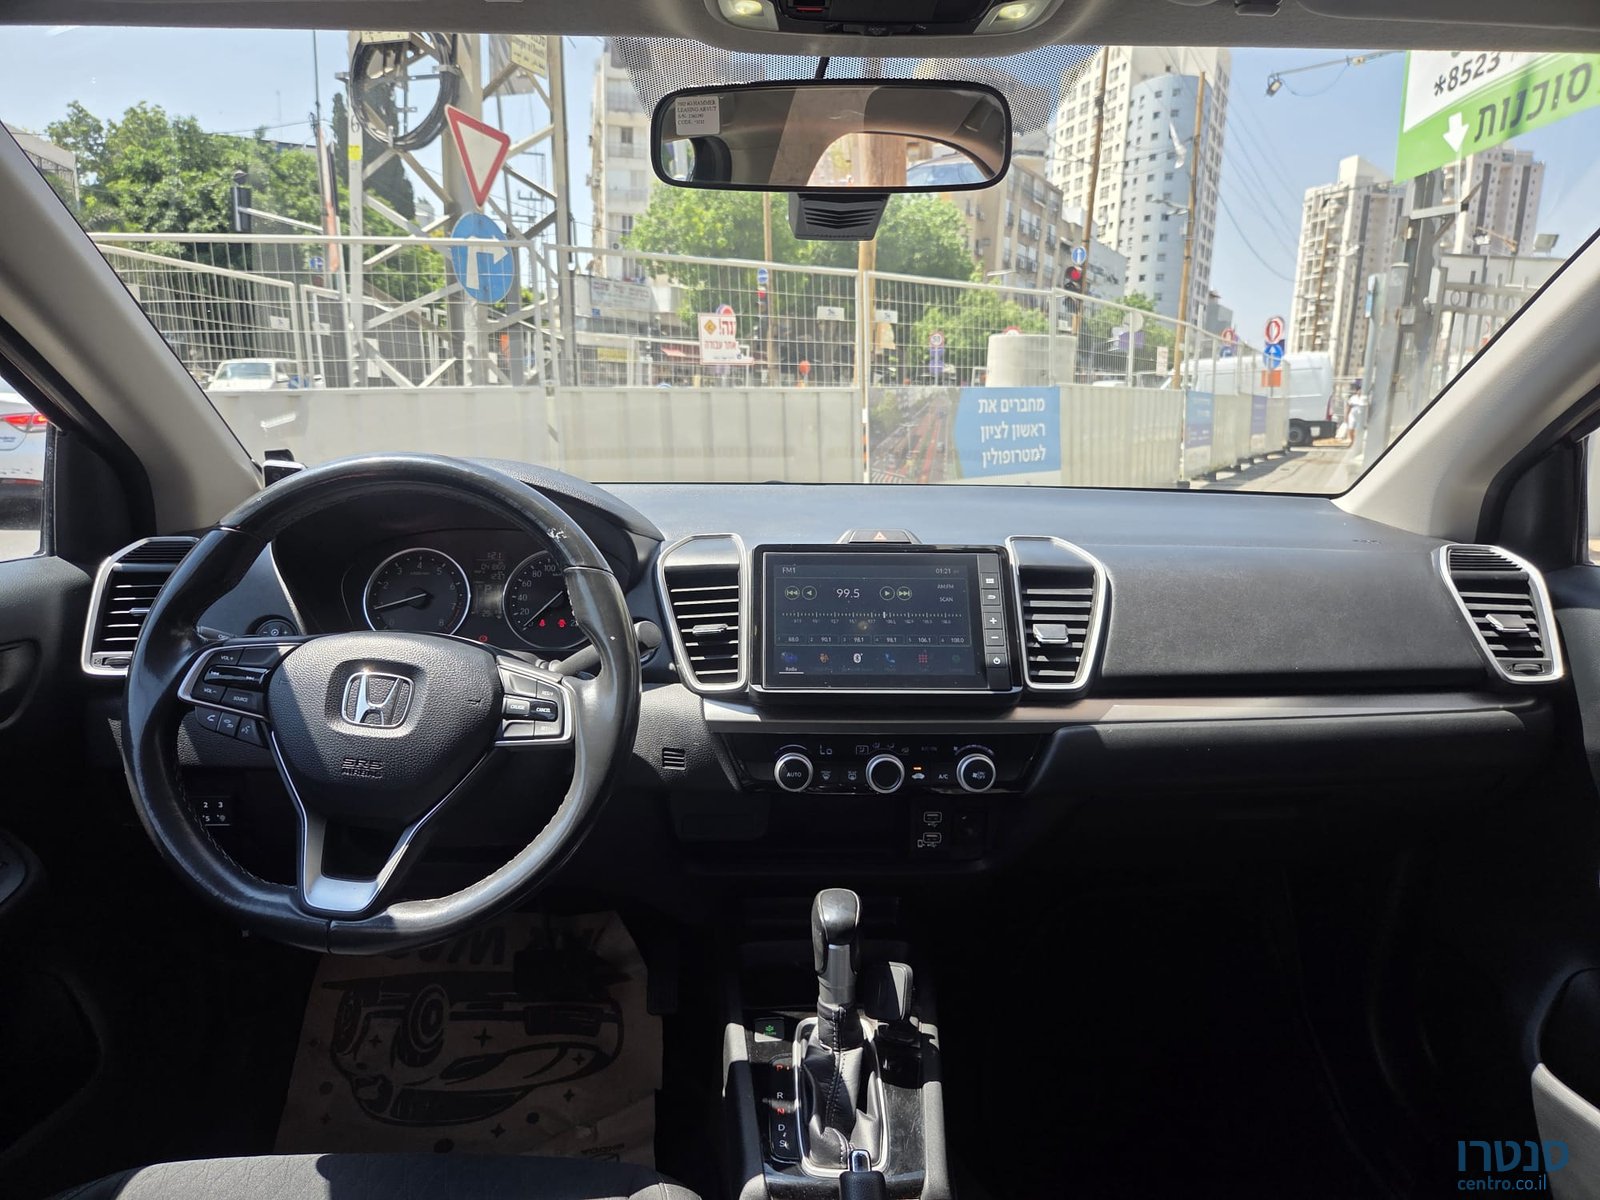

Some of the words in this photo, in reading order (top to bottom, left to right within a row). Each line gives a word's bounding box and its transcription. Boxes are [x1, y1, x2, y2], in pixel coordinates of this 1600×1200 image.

[1473, 62, 1593, 143] סוכנות
[977, 398, 998, 414] את
[1000, 397, 1046, 413] מחברים
[980, 420, 1009, 444] לציון
[1011, 422, 1046, 441] ראשון
[982, 443, 1047, 469] למטרופולין
[416, 561, 422, 569] 4
[544, 564, 556, 572] 100
[436, 567, 442, 575] 5
[532, 570, 542, 578] 80
[782, 566, 796, 574] FM1
[935, 567, 951, 575] 01:21
[450, 582, 456, 590] 6
[521, 580, 532, 588] 60
[836, 588, 860, 598] 99.5
[341, 758, 384, 769] SRS
